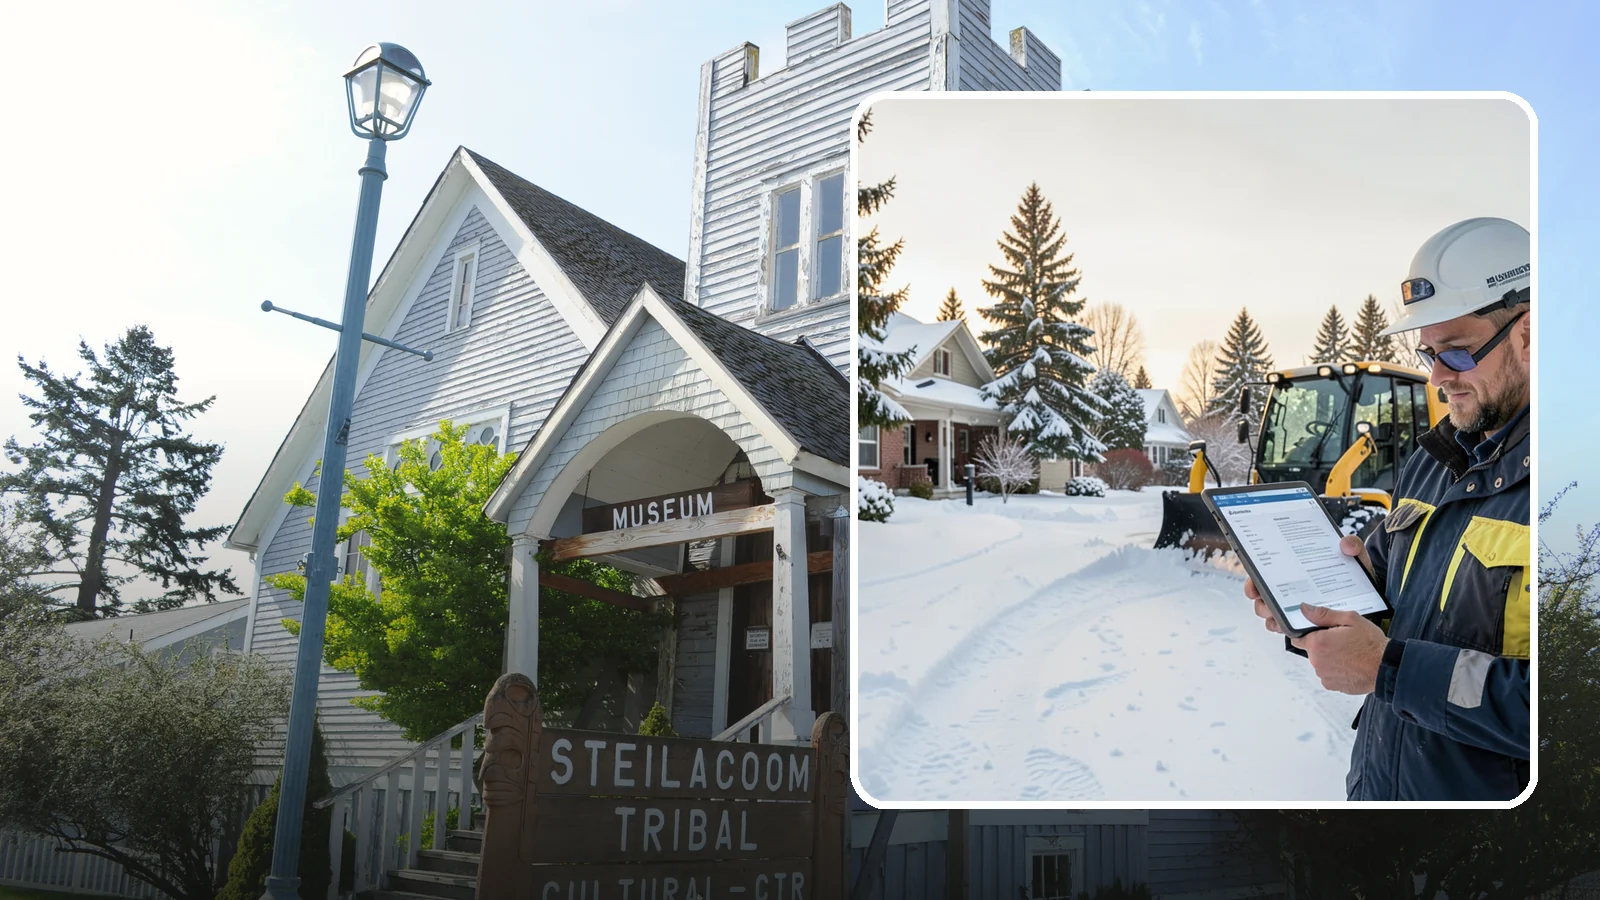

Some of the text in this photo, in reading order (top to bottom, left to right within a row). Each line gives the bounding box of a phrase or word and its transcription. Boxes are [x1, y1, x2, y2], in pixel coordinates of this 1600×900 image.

[613, 491, 713, 530] MUSEUM
[551, 738, 809, 792] STEILACOOM
[615, 806, 757, 852] TRIBAL
